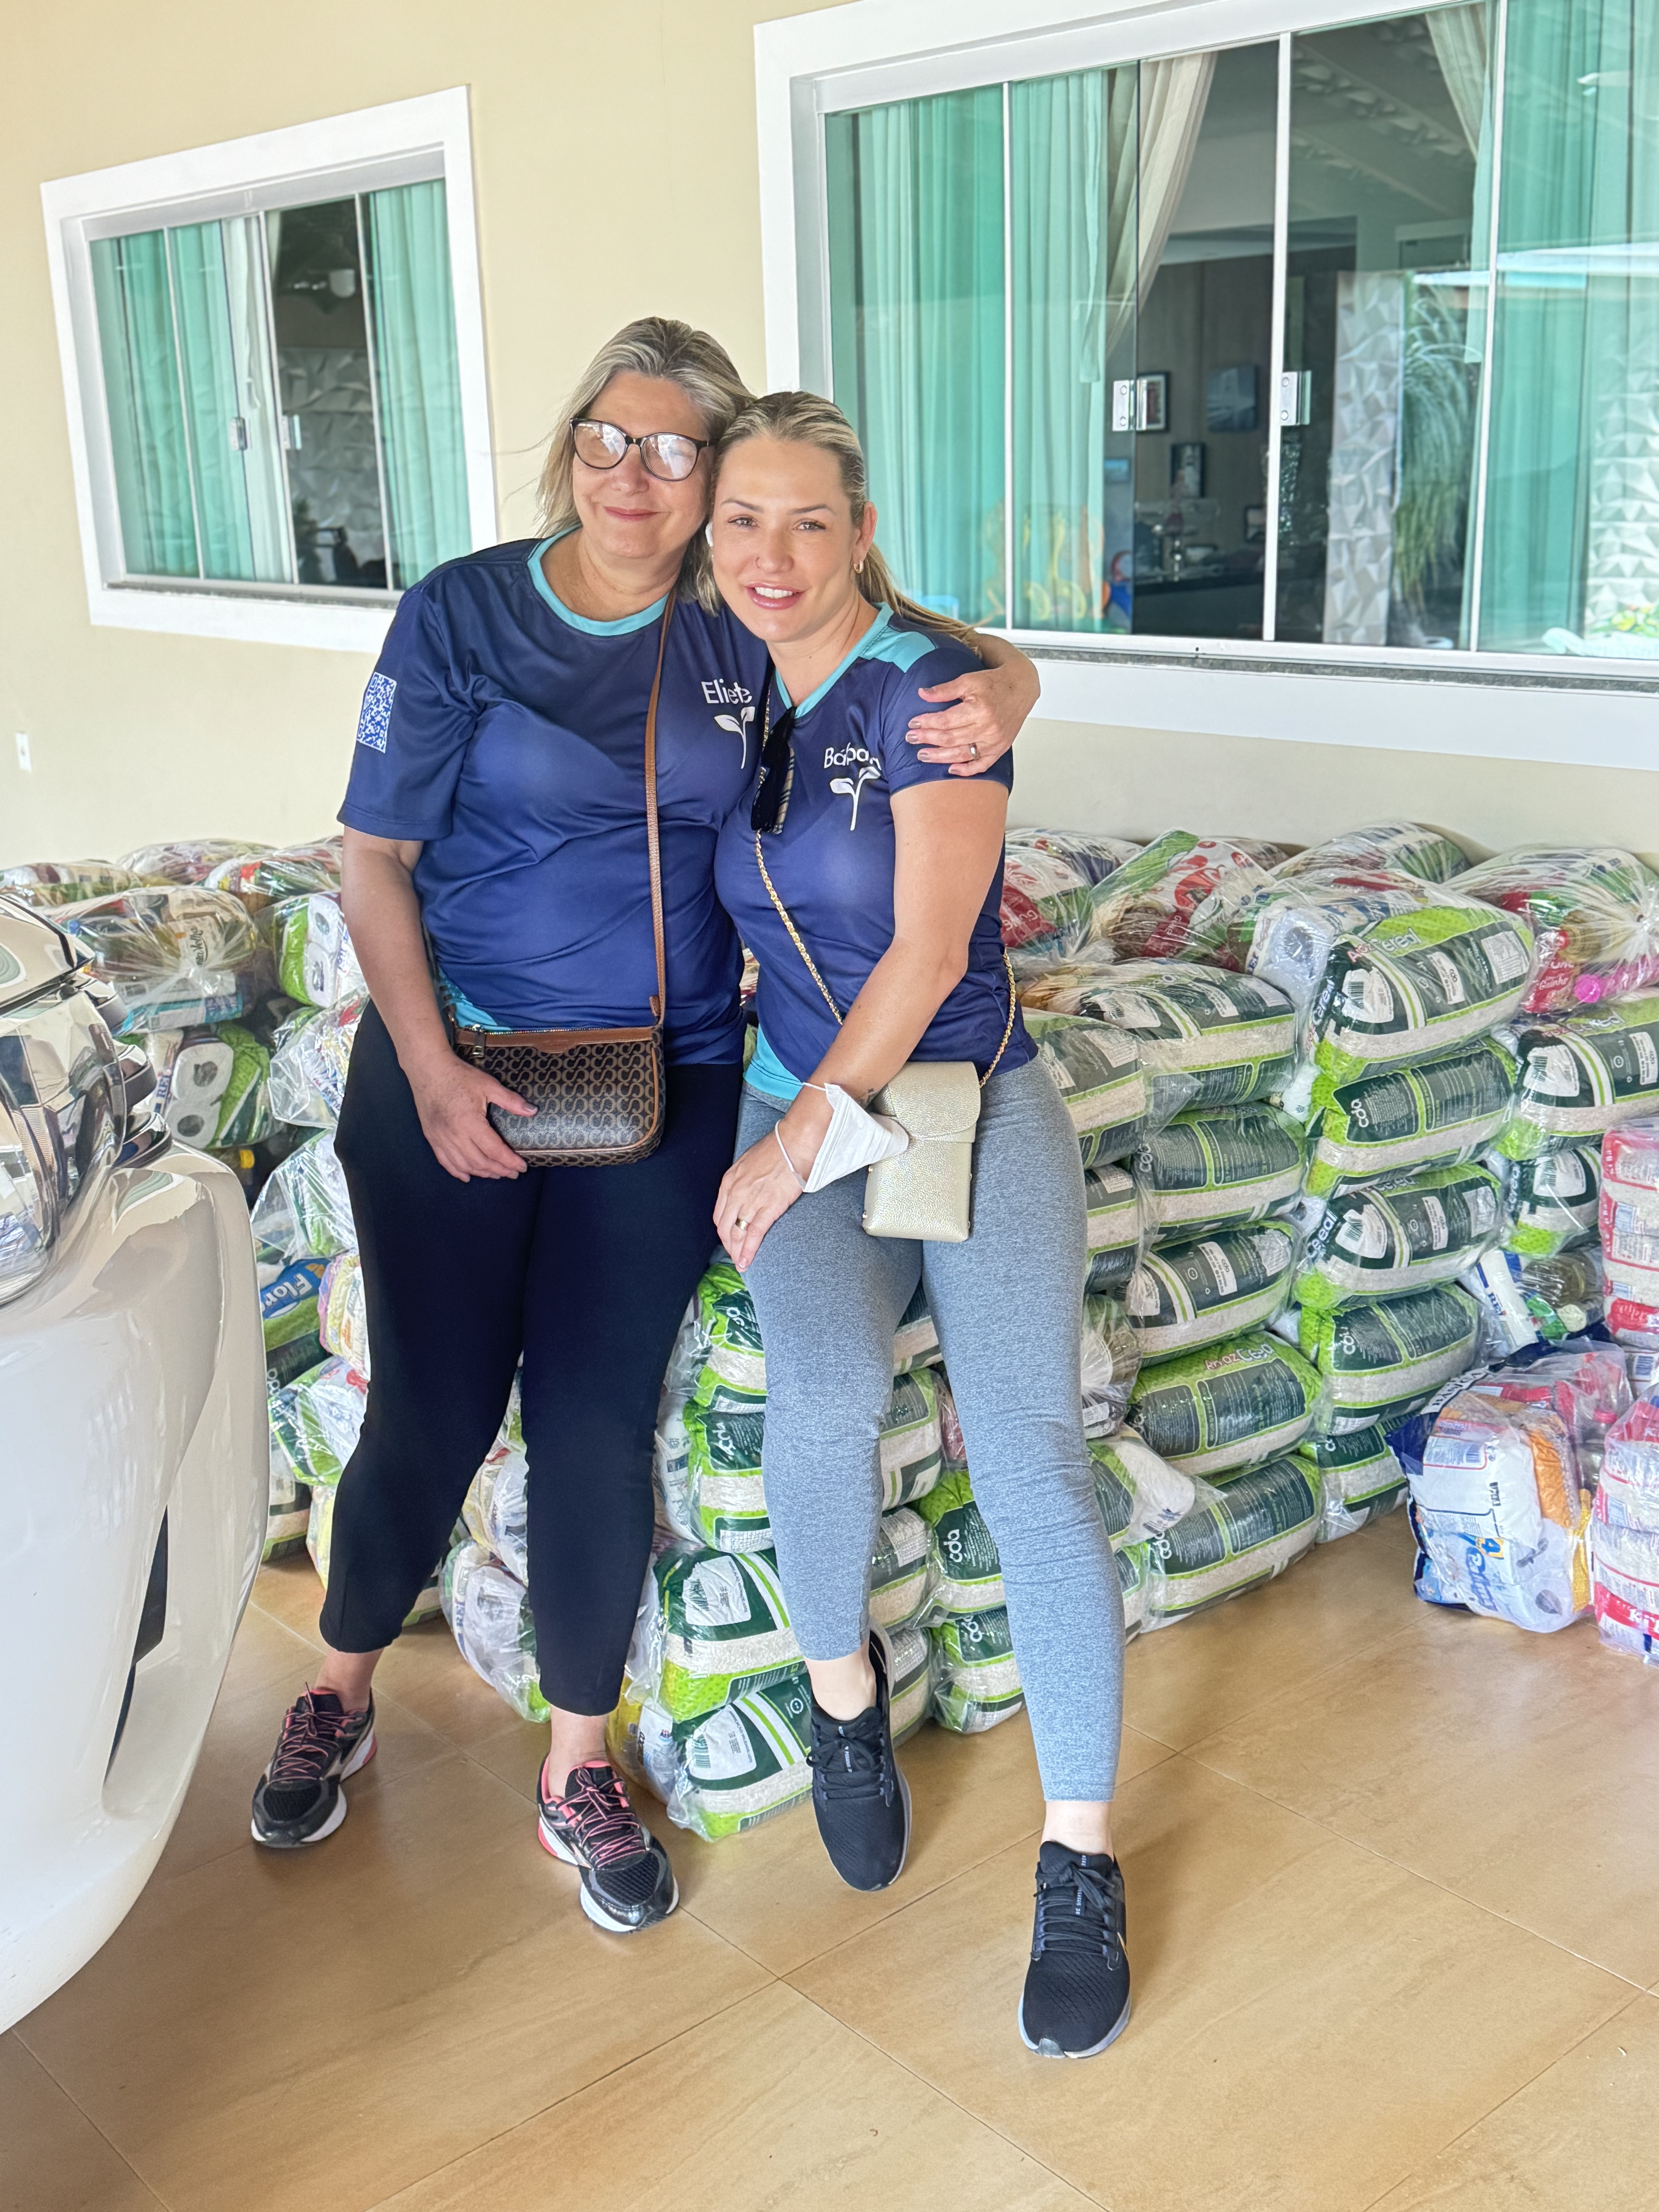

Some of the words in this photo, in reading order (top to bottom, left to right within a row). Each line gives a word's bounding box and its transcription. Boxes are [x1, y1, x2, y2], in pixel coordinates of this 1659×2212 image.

[701, 678, 752, 704] Eliete
[1351, 1099, 1369, 1128] cda
[943, 1528, 963, 1563] cda
